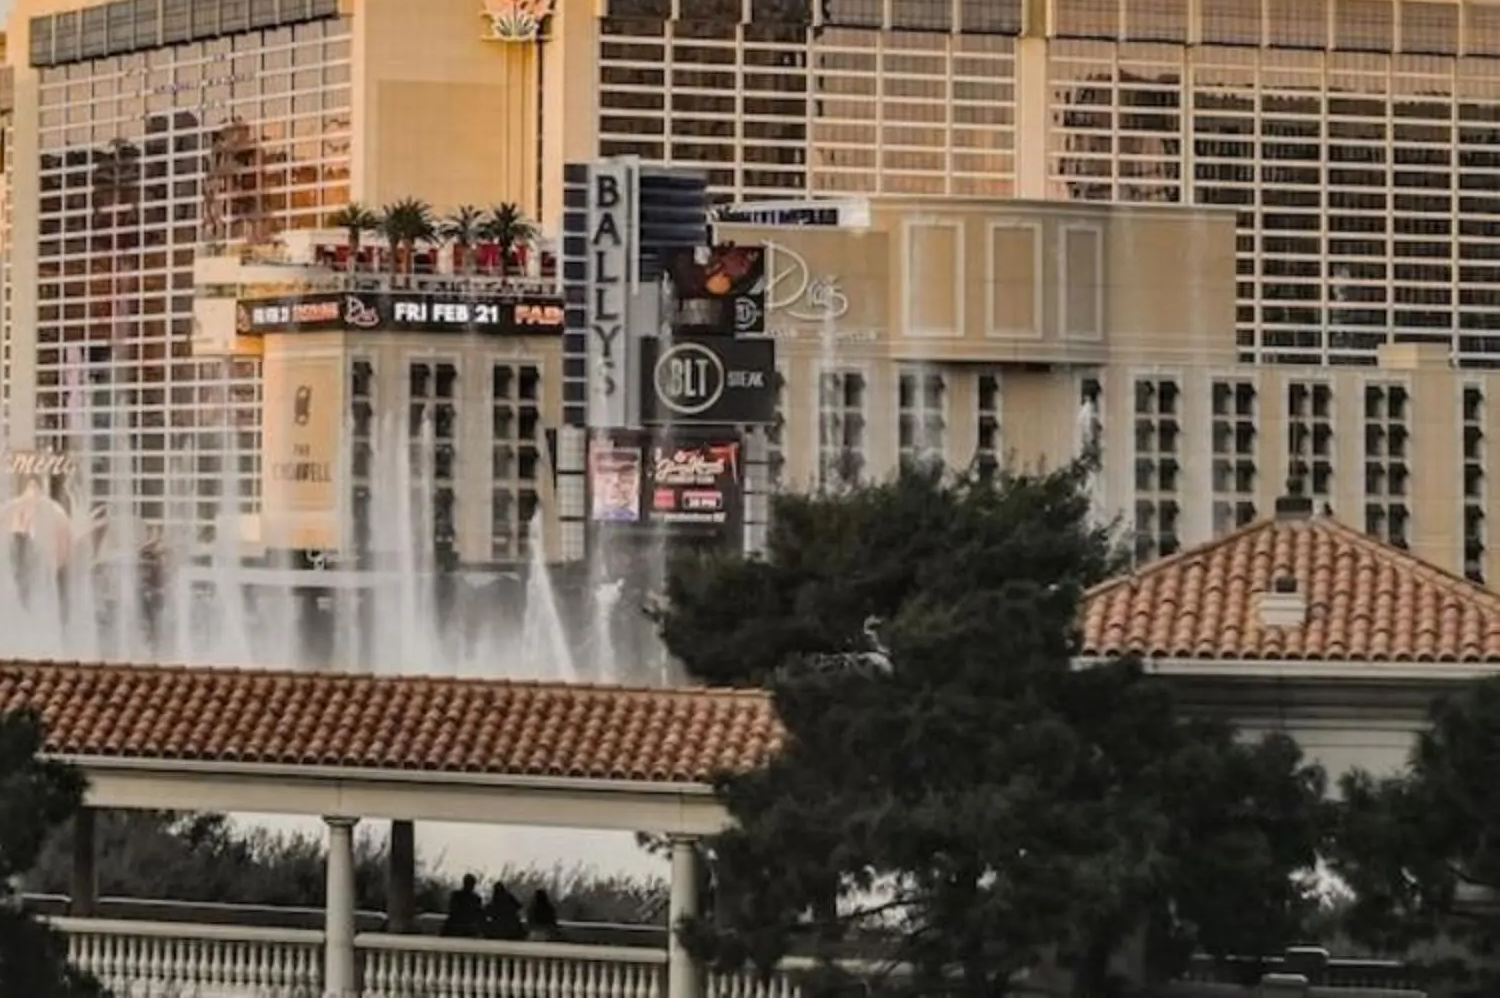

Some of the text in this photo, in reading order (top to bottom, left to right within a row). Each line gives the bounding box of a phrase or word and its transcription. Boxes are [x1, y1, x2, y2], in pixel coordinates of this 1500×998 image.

[393, 302, 498, 324] FRI FEB 21
[670, 357, 709, 397] BLT
